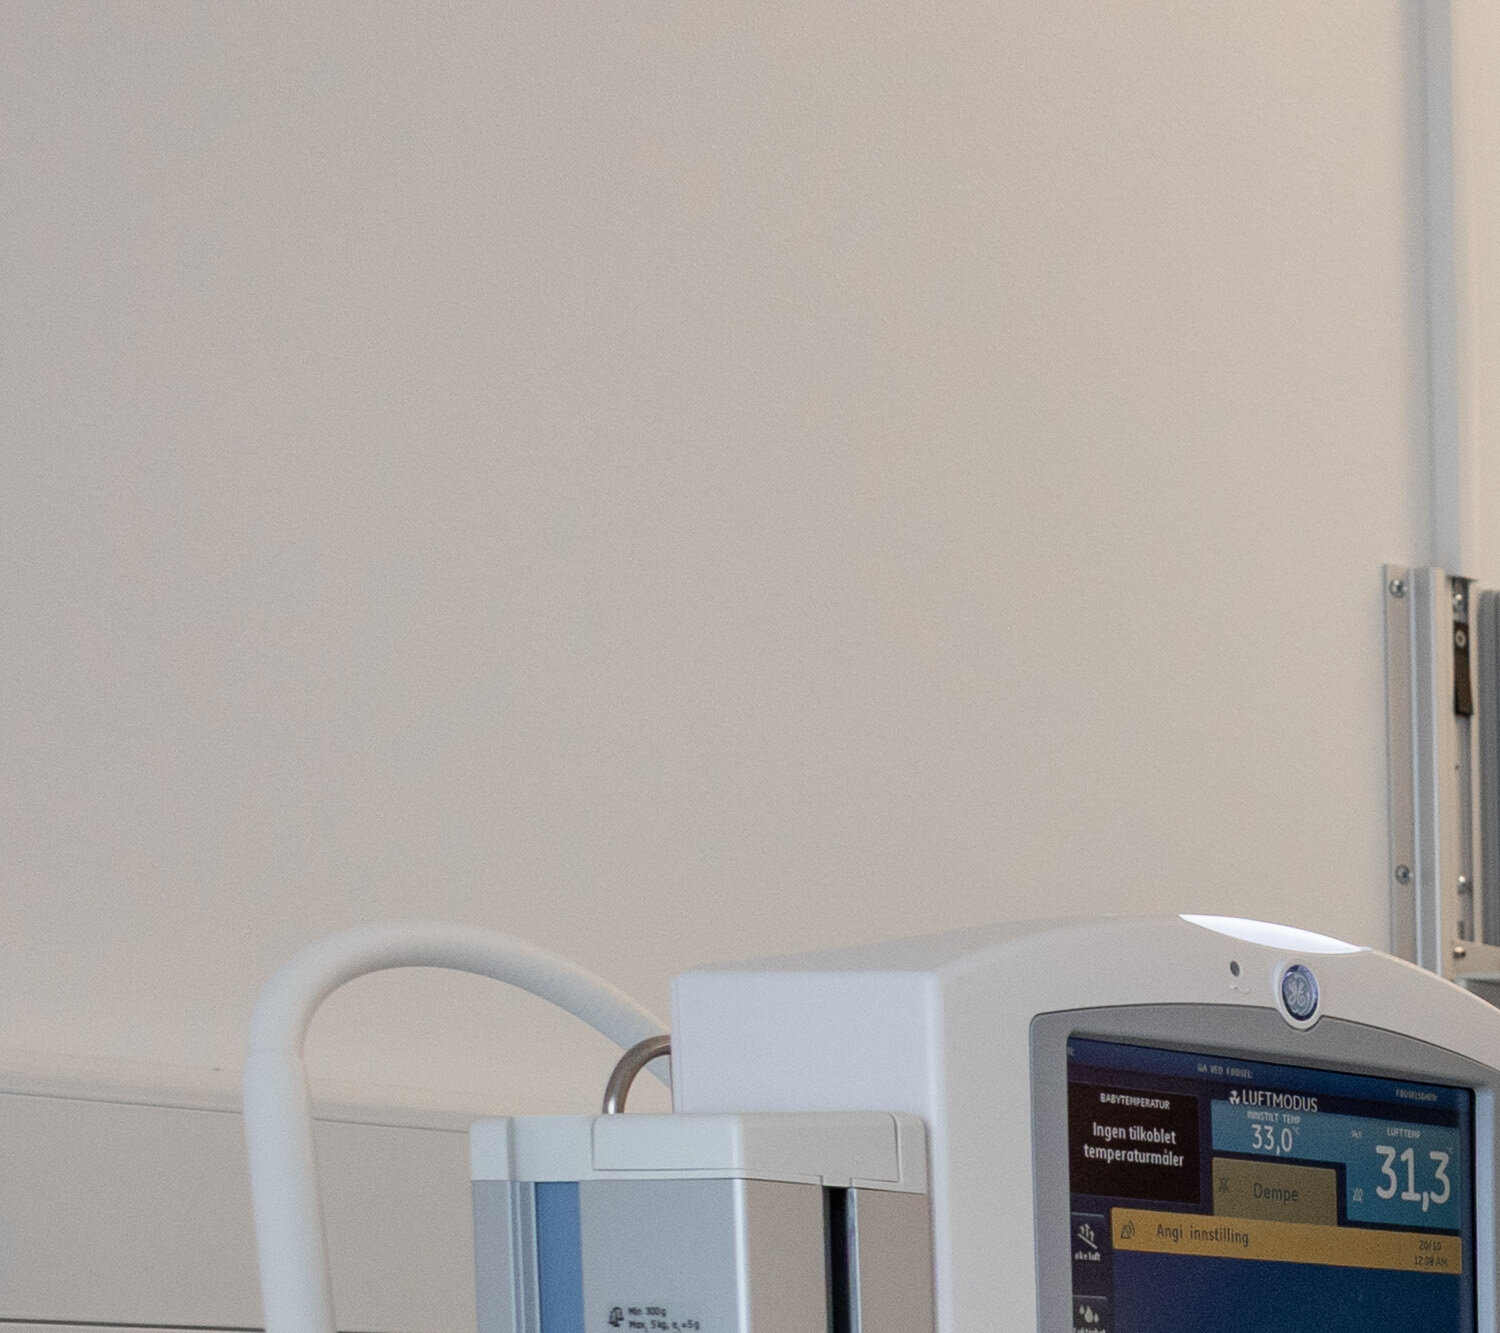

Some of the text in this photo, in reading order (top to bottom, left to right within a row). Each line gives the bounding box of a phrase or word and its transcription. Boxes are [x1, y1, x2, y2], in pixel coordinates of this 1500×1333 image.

[1242, 1090, 1319, 1113] LUFTMODUS
[1093, 1122, 1177, 1145] Ingen tilkoblet
[1251, 1124, 1293, 1156] 33,0
[1083, 1144, 1184, 1168] temperaturmåler
[1375, 1145, 1450, 1212] 31,3
[1254, 1183, 1299, 1204] Dempe
[1156, 1224, 1250, 1246] Angi innstilling
